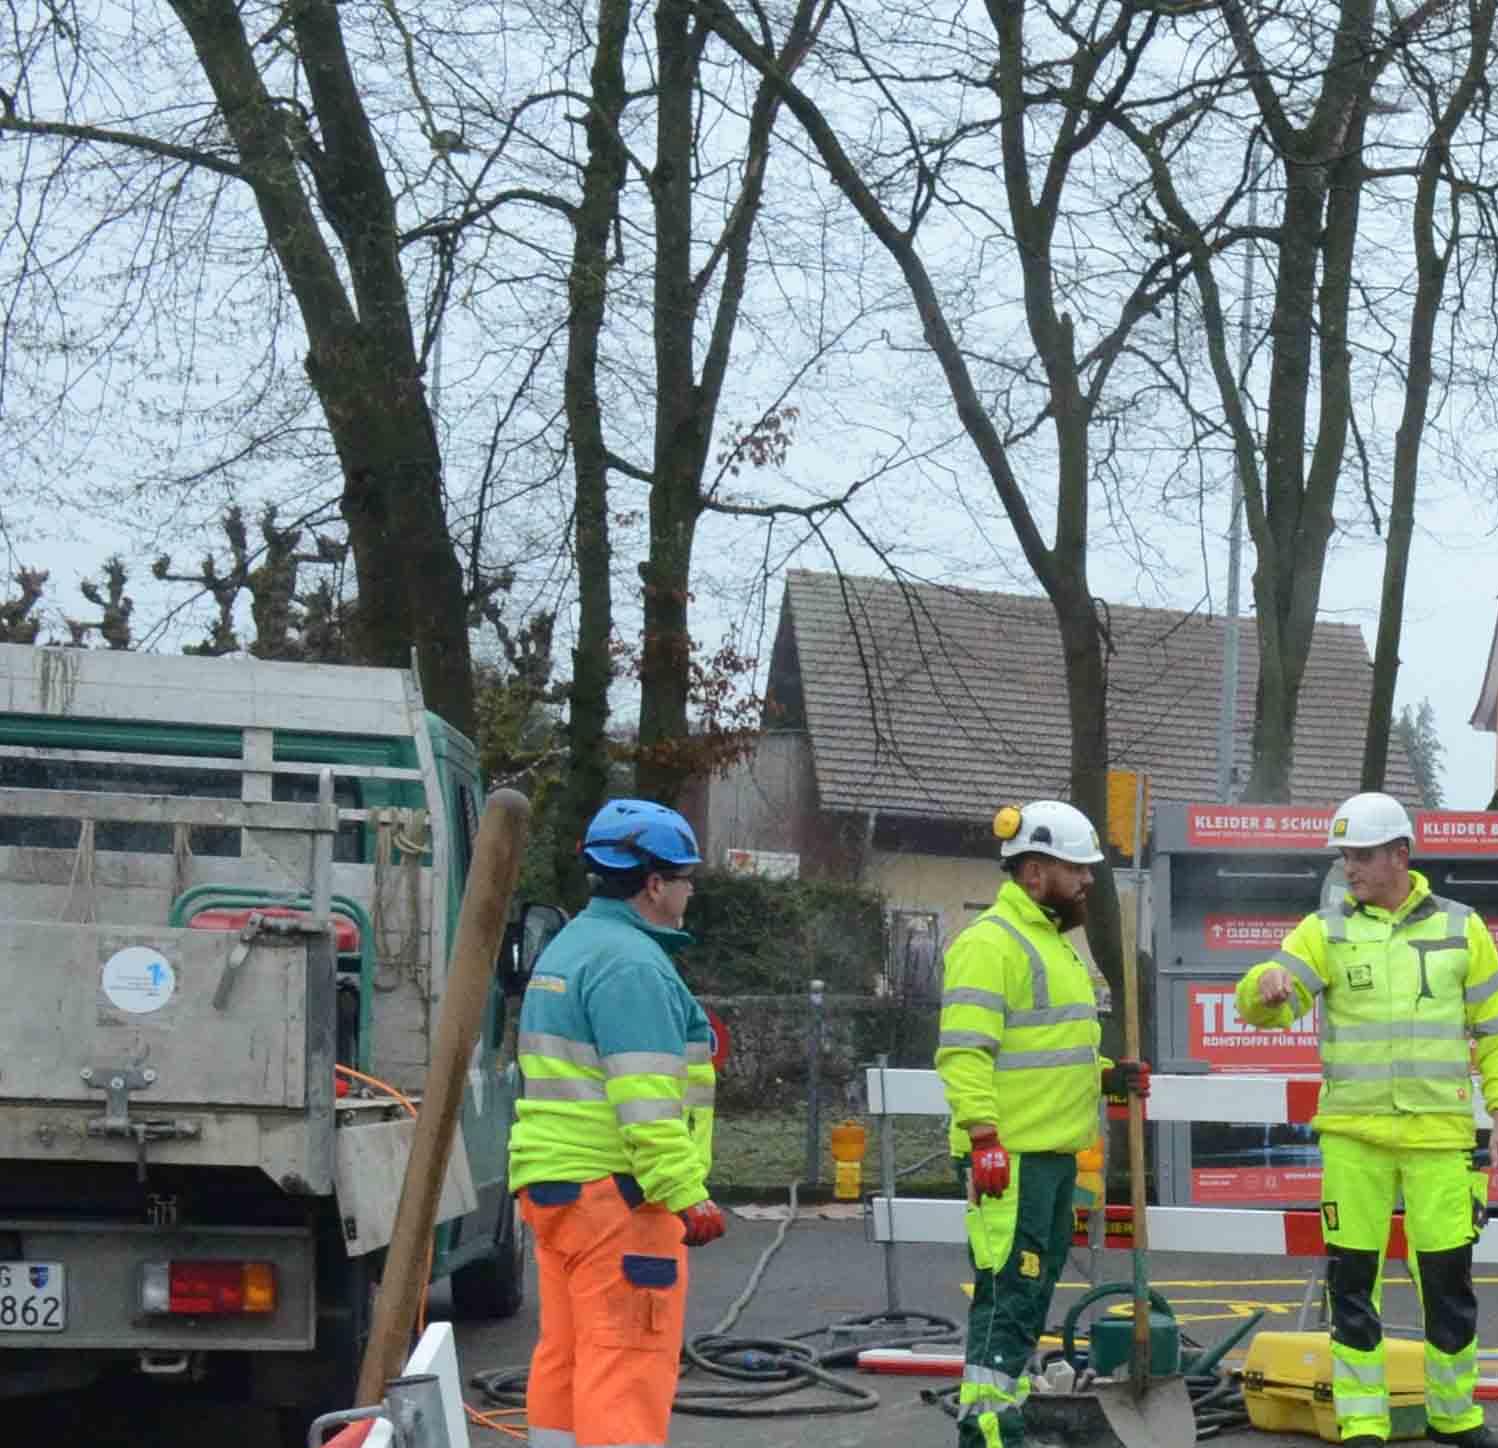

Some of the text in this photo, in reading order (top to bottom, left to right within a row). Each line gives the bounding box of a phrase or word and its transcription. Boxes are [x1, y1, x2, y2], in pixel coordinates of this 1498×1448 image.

[1195, 816, 1261, 832] KLEIDER
[1264, 817, 1275, 832] &
[1423, 823, 1487, 836] KLEIDER
[1, 1295, 60, 1327] 862
